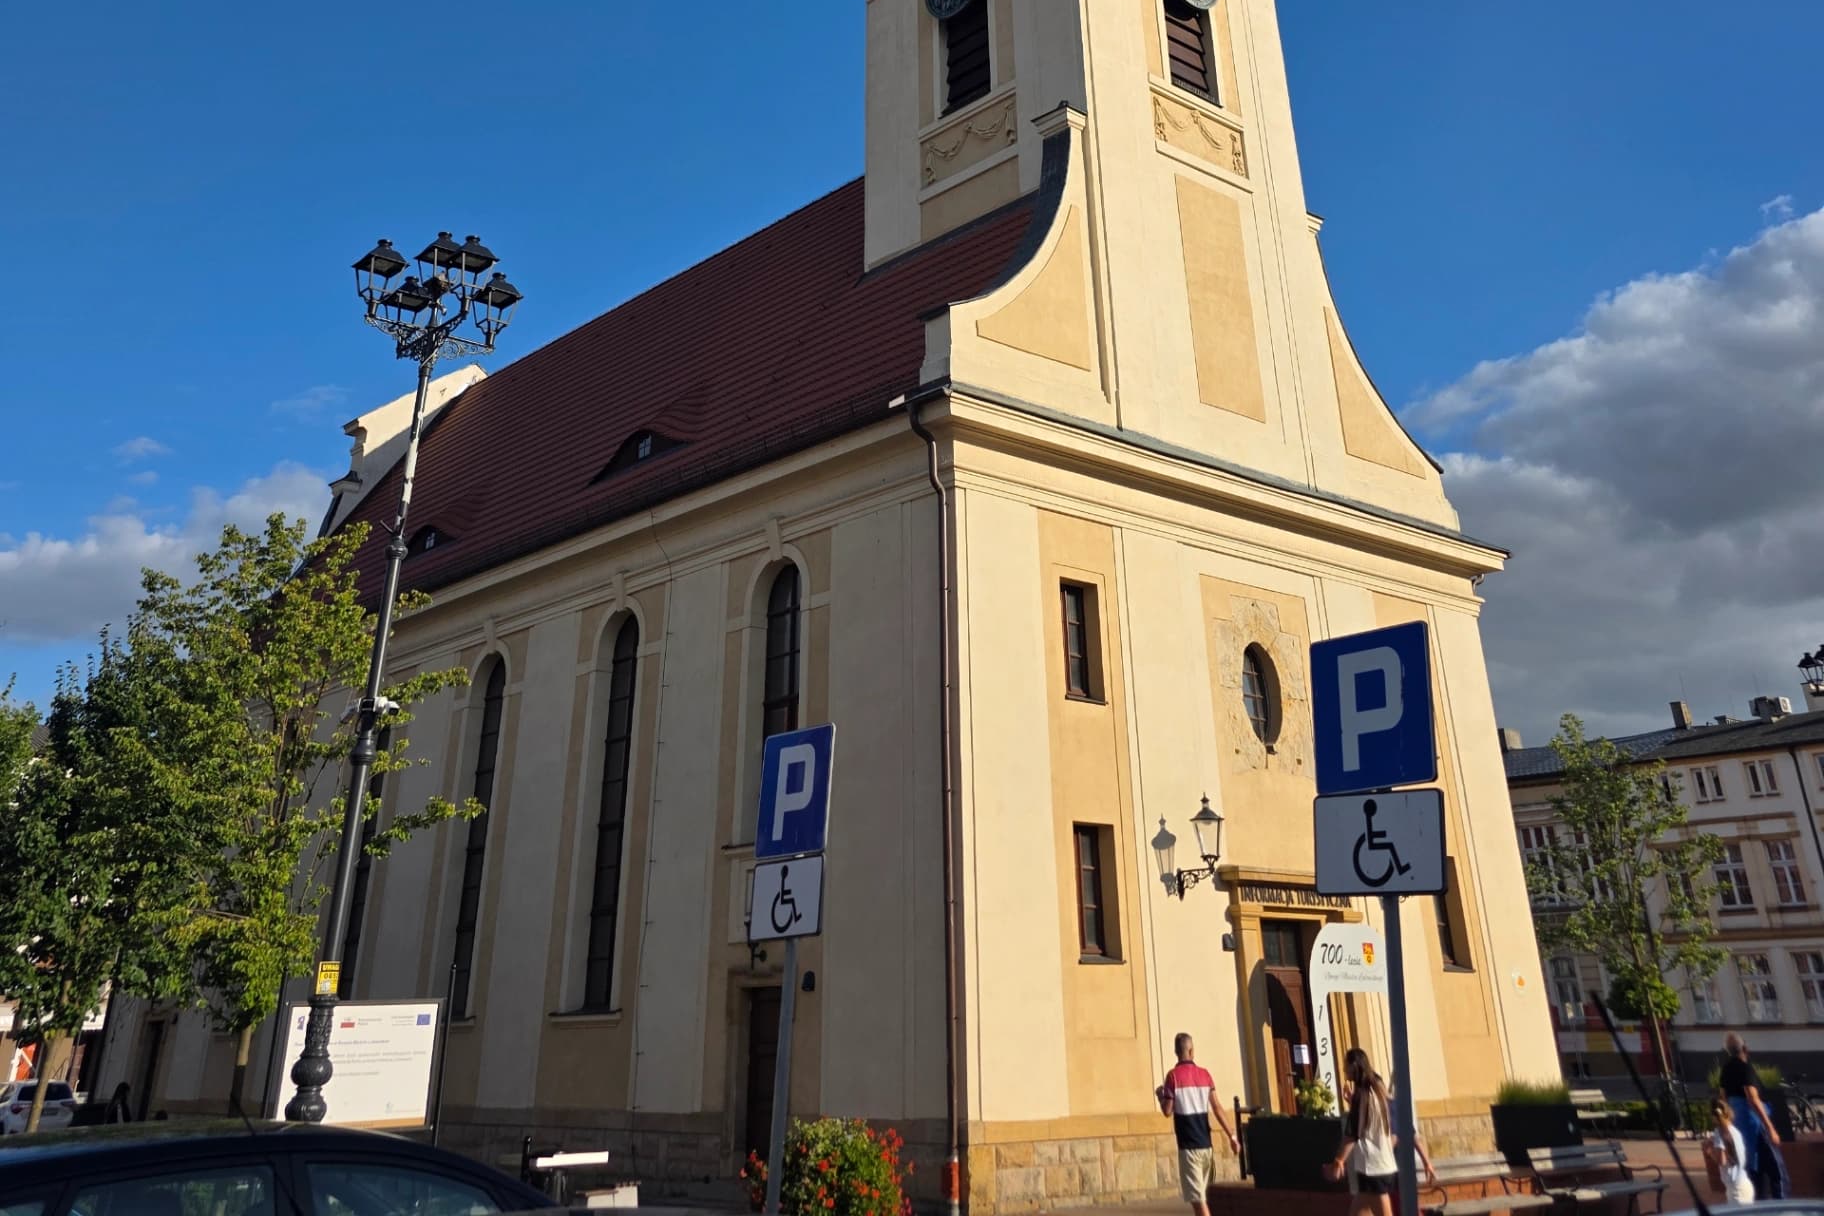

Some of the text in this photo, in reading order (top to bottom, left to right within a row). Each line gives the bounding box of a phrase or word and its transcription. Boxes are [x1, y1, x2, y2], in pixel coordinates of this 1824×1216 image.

[1337, 646, 1404, 772] P
[772, 743, 816, 841] P
[1240, 886, 1294, 907] INFORMACJA
[1320, 943, 1343, 965] 700
